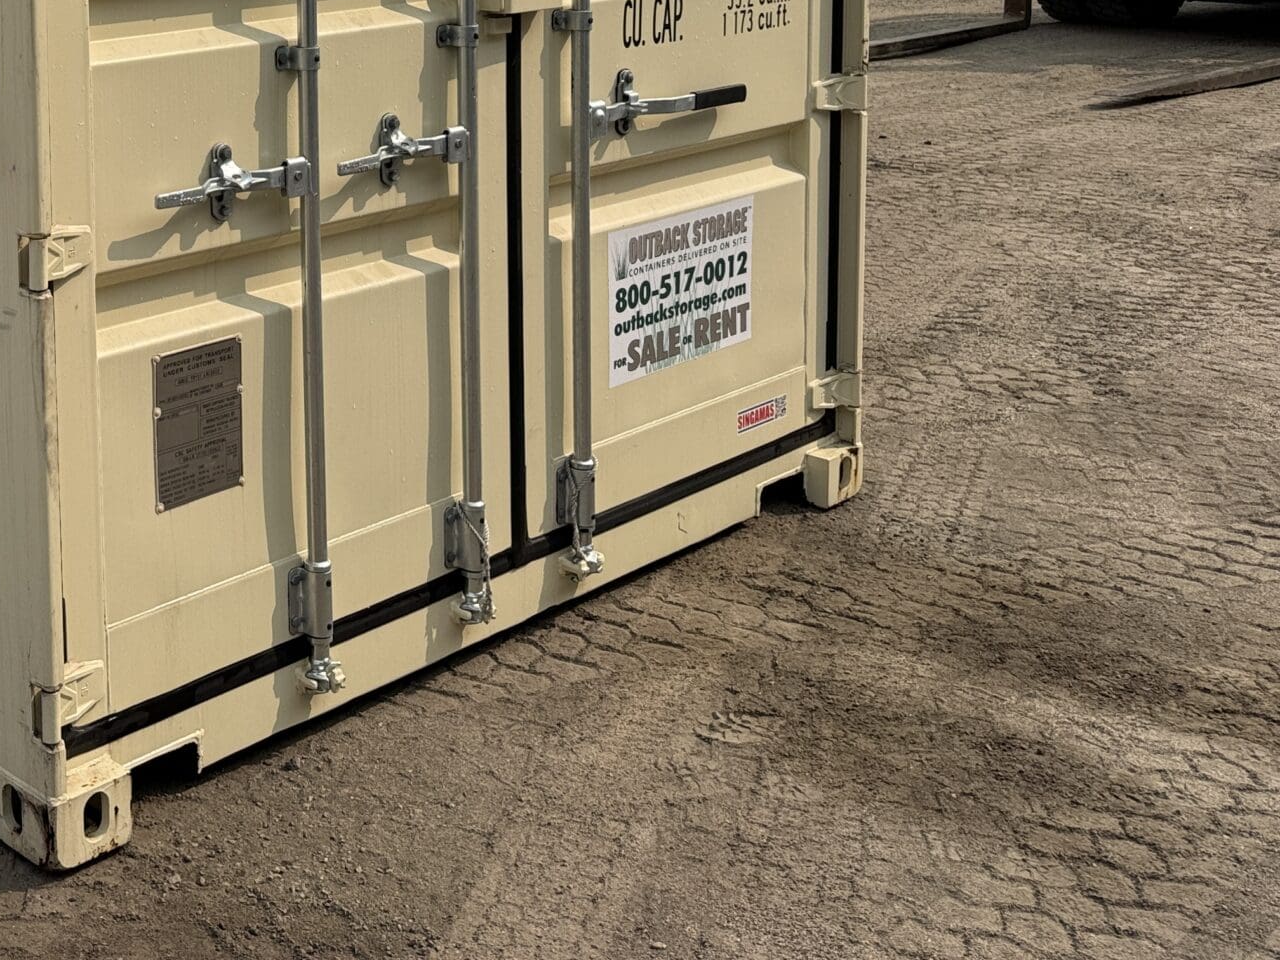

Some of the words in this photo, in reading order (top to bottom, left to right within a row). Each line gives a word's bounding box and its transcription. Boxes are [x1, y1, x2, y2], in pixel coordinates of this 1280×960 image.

[722, 13, 727, 36] 1
[734, 9, 754, 35] 173
[758, 4, 791, 30] cu.ft.
[628, 222, 691, 265] OUTBACK
[693, 207, 748, 247] STORAGE
[628, 256, 676, 277] CONTAINERS
[677, 245, 718, 263] DELIVERED
[719, 240, 731, 251] ON
[732, 235, 748, 247] SITE
[615, 250, 748, 313] 800-517-0012
[614, 282, 747, 336] outbackstorage.com
[614, 357, 627, 370] FOR
[627, 326, 681, 372] SALE
[682, 334, 693, 346] OR
[694, 302, 751, 350] RENT
[163, 366, 184, 378] UNDER
[187, 358, 217, 371] CUSTOMS
[219, 353, 234, 362] SEAL
[737, 403, 775, 430] SINGAMAS
